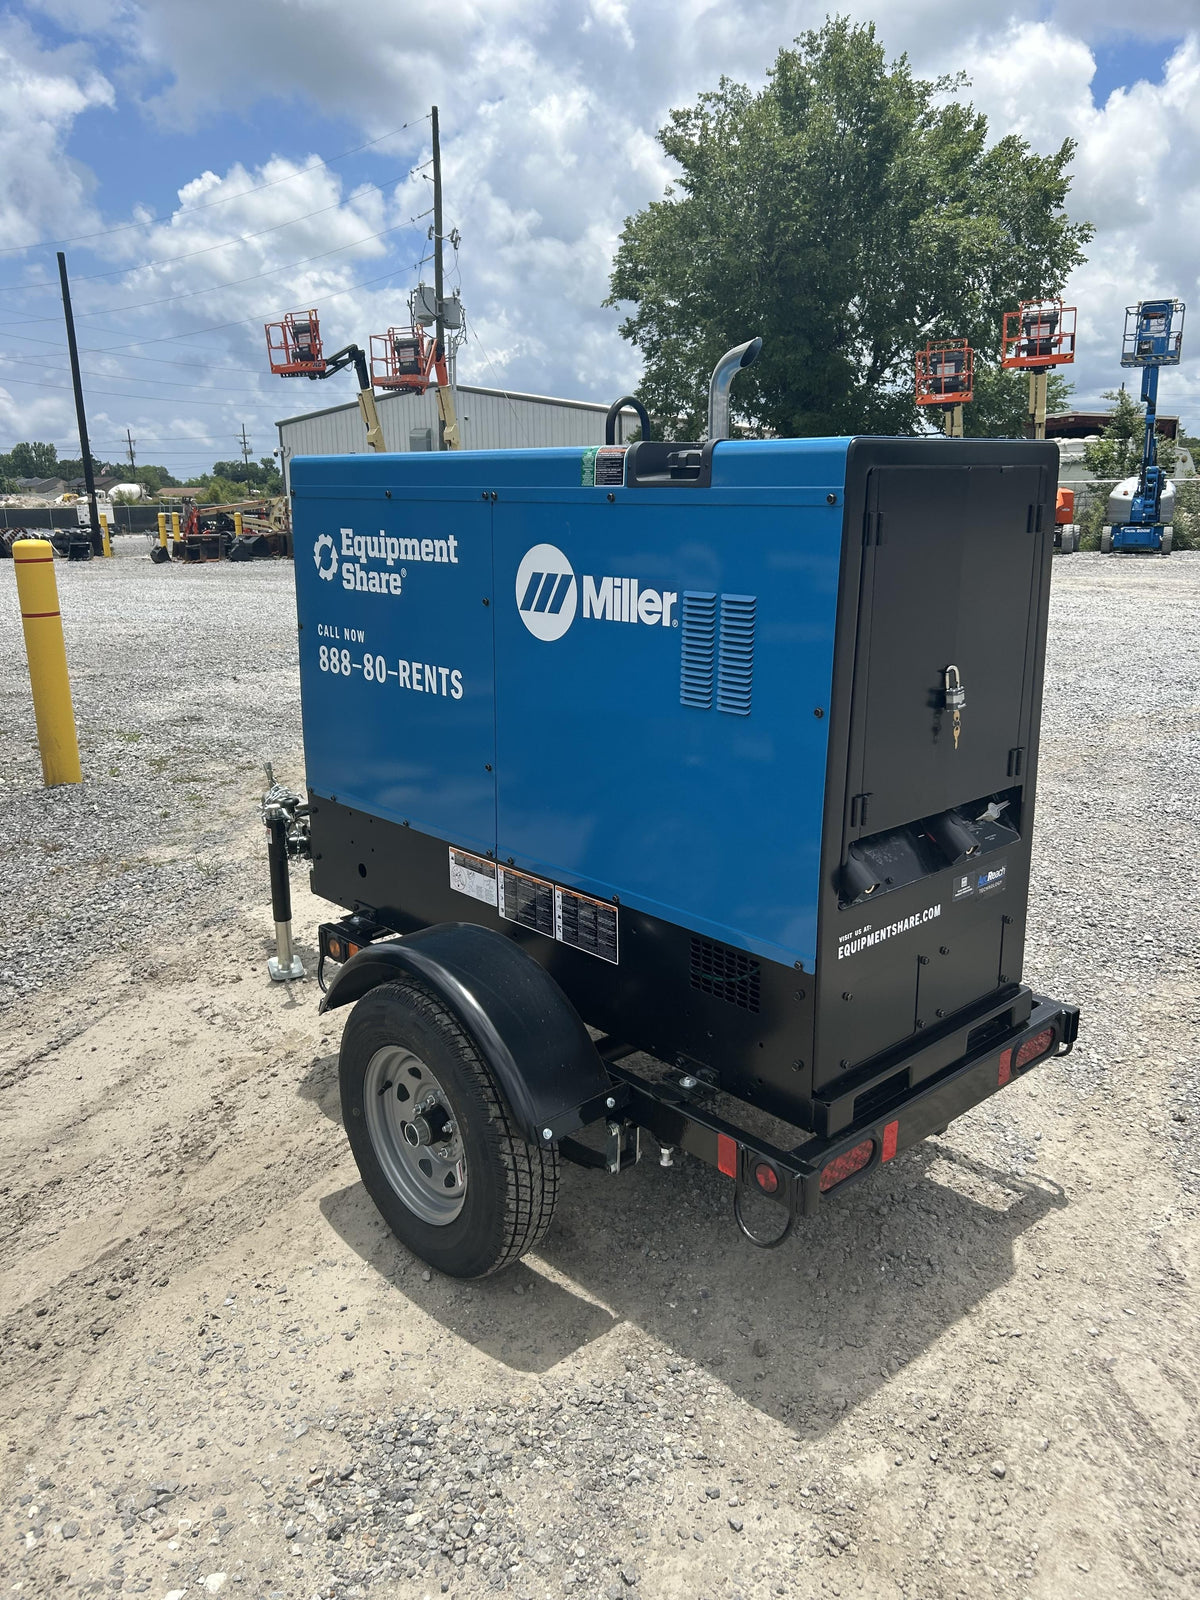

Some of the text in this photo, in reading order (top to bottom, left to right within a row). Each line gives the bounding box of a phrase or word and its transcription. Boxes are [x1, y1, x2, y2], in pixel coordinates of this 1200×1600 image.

[340, 527, 459, 565] Equipment
[342, 562, 402, 595] Share
[582, 575, 678, 627] Miller
[318, 623, 365, 643] CALL NOW
[319, 645, 464, 700] 888-80-RENTS
[838, 903, 941, 960] EQUIPMENTSHARE.COM
[838, 924, 872, 943] VISIT US AT:
